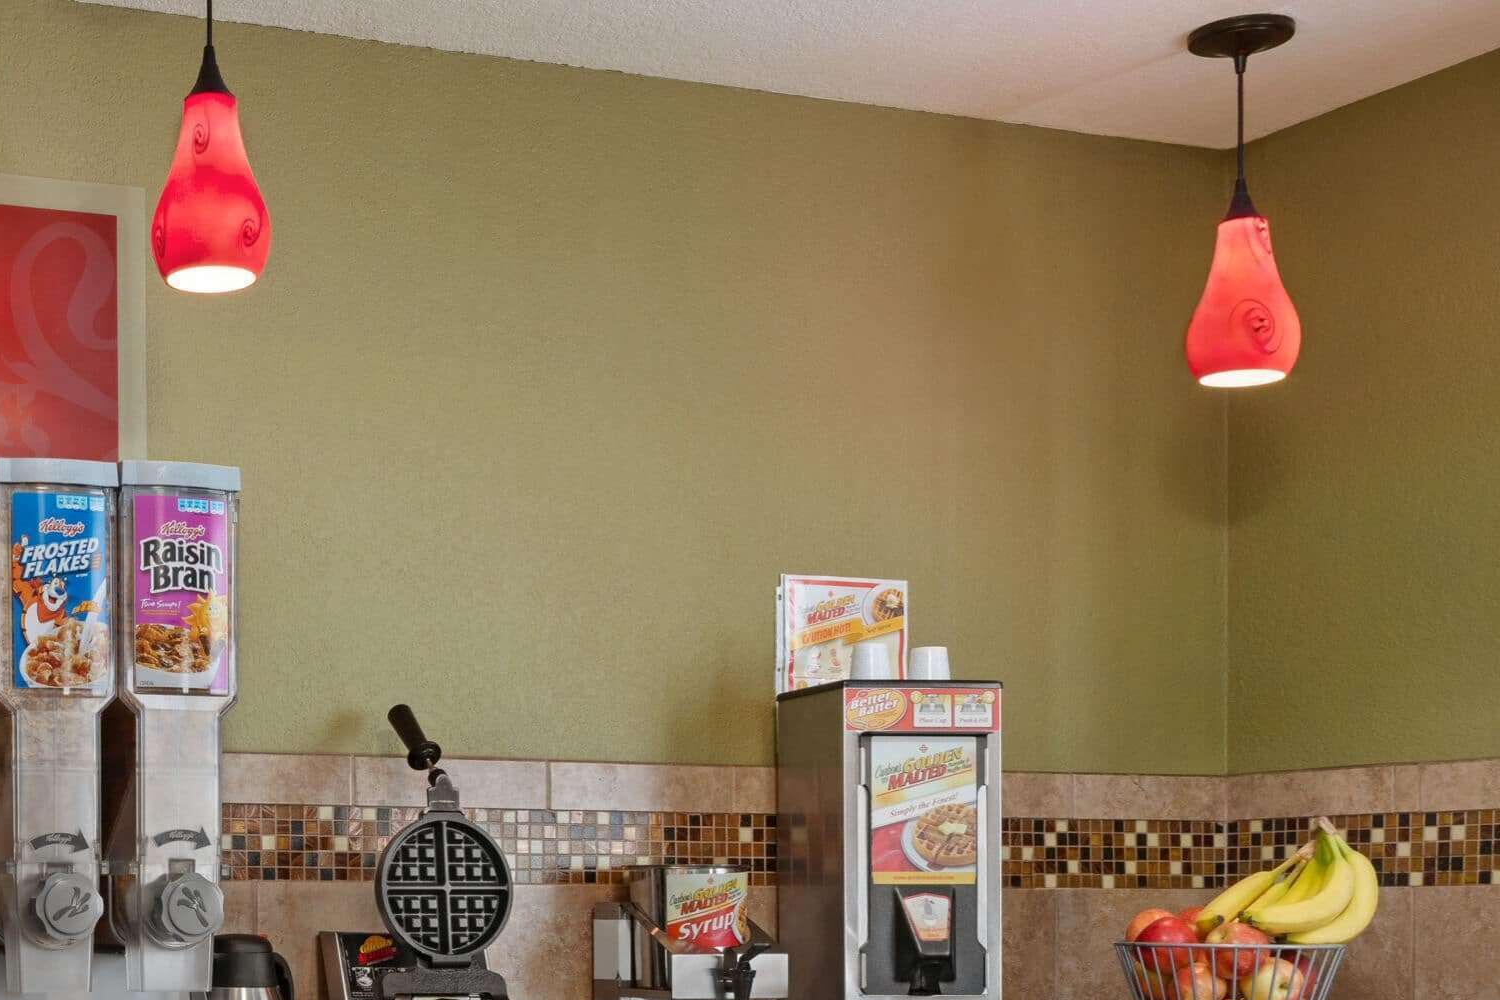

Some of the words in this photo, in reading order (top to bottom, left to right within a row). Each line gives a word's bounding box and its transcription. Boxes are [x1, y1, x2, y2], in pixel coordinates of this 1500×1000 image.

[38, 517, 85, 537] Kellogg's
[158, 520, 205, 540] Kellogg's
[21, 537, 99, 563] FROSTED
[140, 537, 223, 570] Raisin
[23, 554, 90, 579] FLAKES
[151, 563, 214, 593] Bran
[888, 764, 948, 791] MALTED
[678, 911, 735, 940] Syrup
